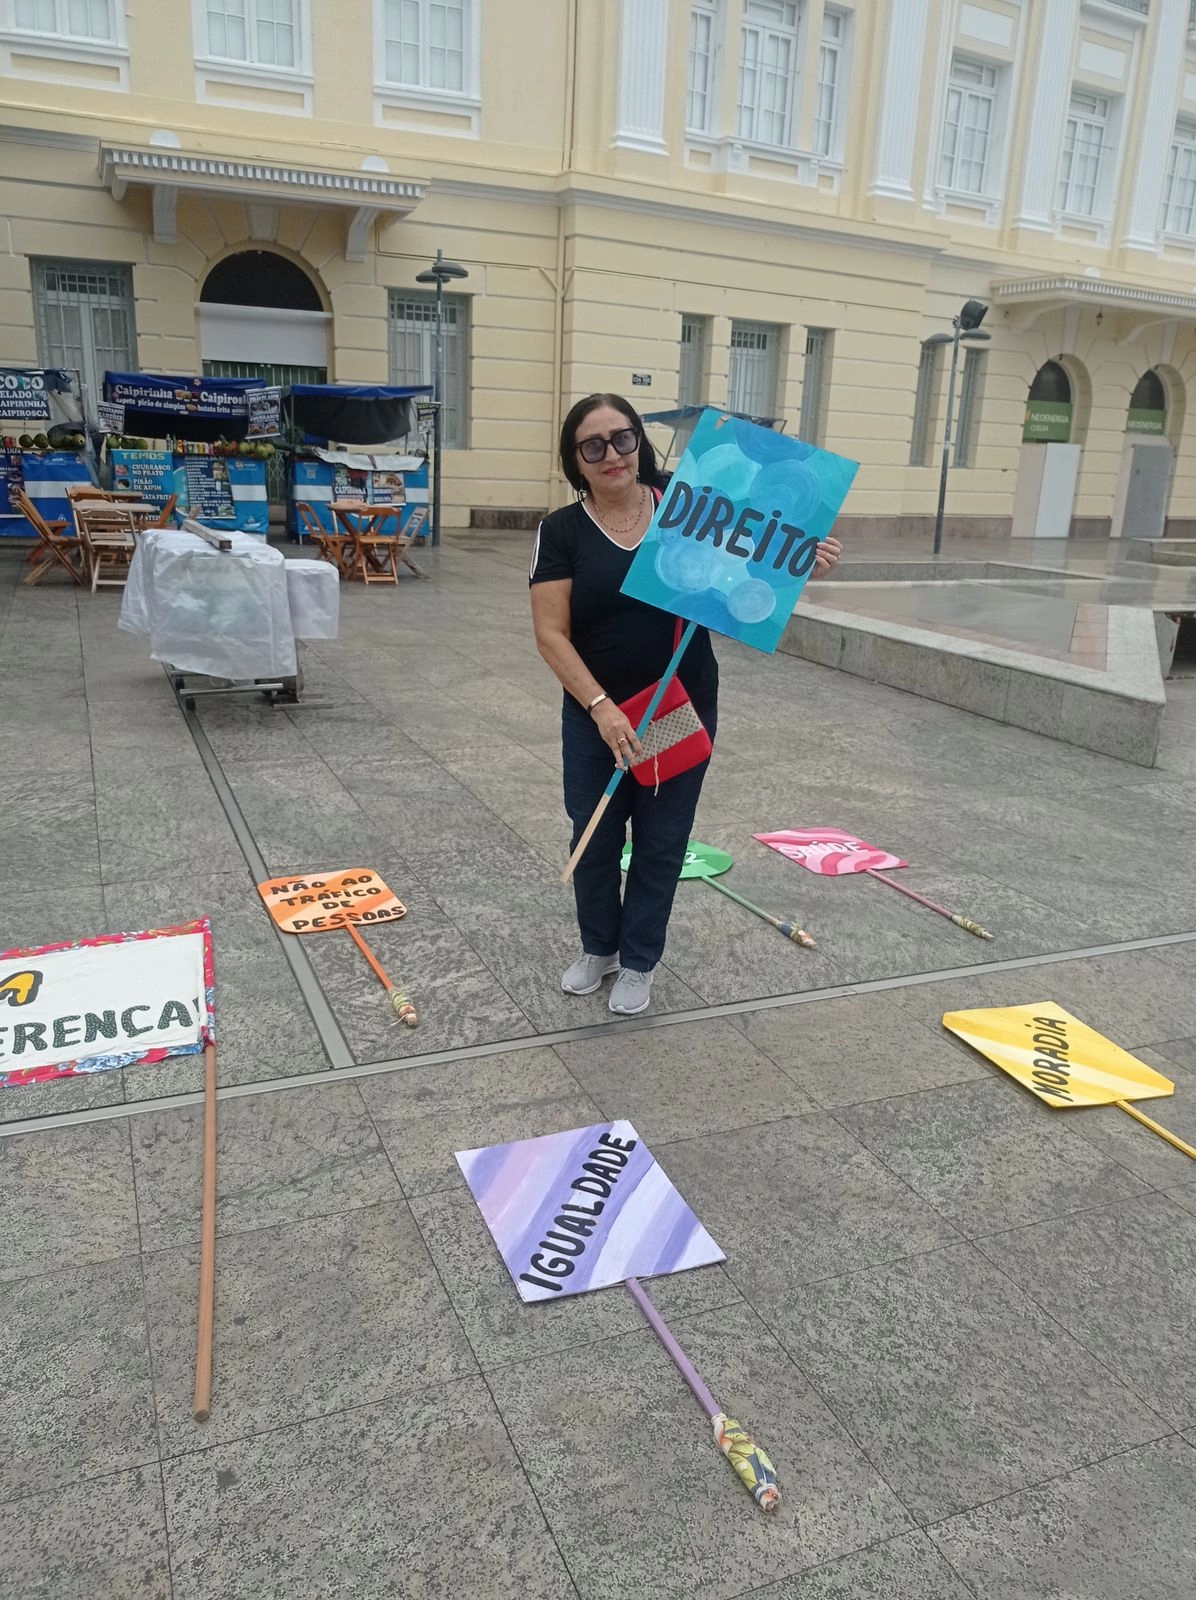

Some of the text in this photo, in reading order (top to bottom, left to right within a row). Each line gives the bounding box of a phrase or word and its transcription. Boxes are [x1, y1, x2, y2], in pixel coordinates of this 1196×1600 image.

[115, 384, 173, 399] Caipirinha
[0, 409, 49, 417] AIPIROSCA
[1031, 412, 1069, 424] NEOENERGIA
[121, 452, 165, 460] TEMOS
[778, 841, 868, 859] SAÚDE
[270, 875, 372, 895] NÃO AO
[322, 900, 355, 910] DE
[292, 906, 404, 930] PESSOAS
[519, 1132, 636, 1292] IGUALDADE
